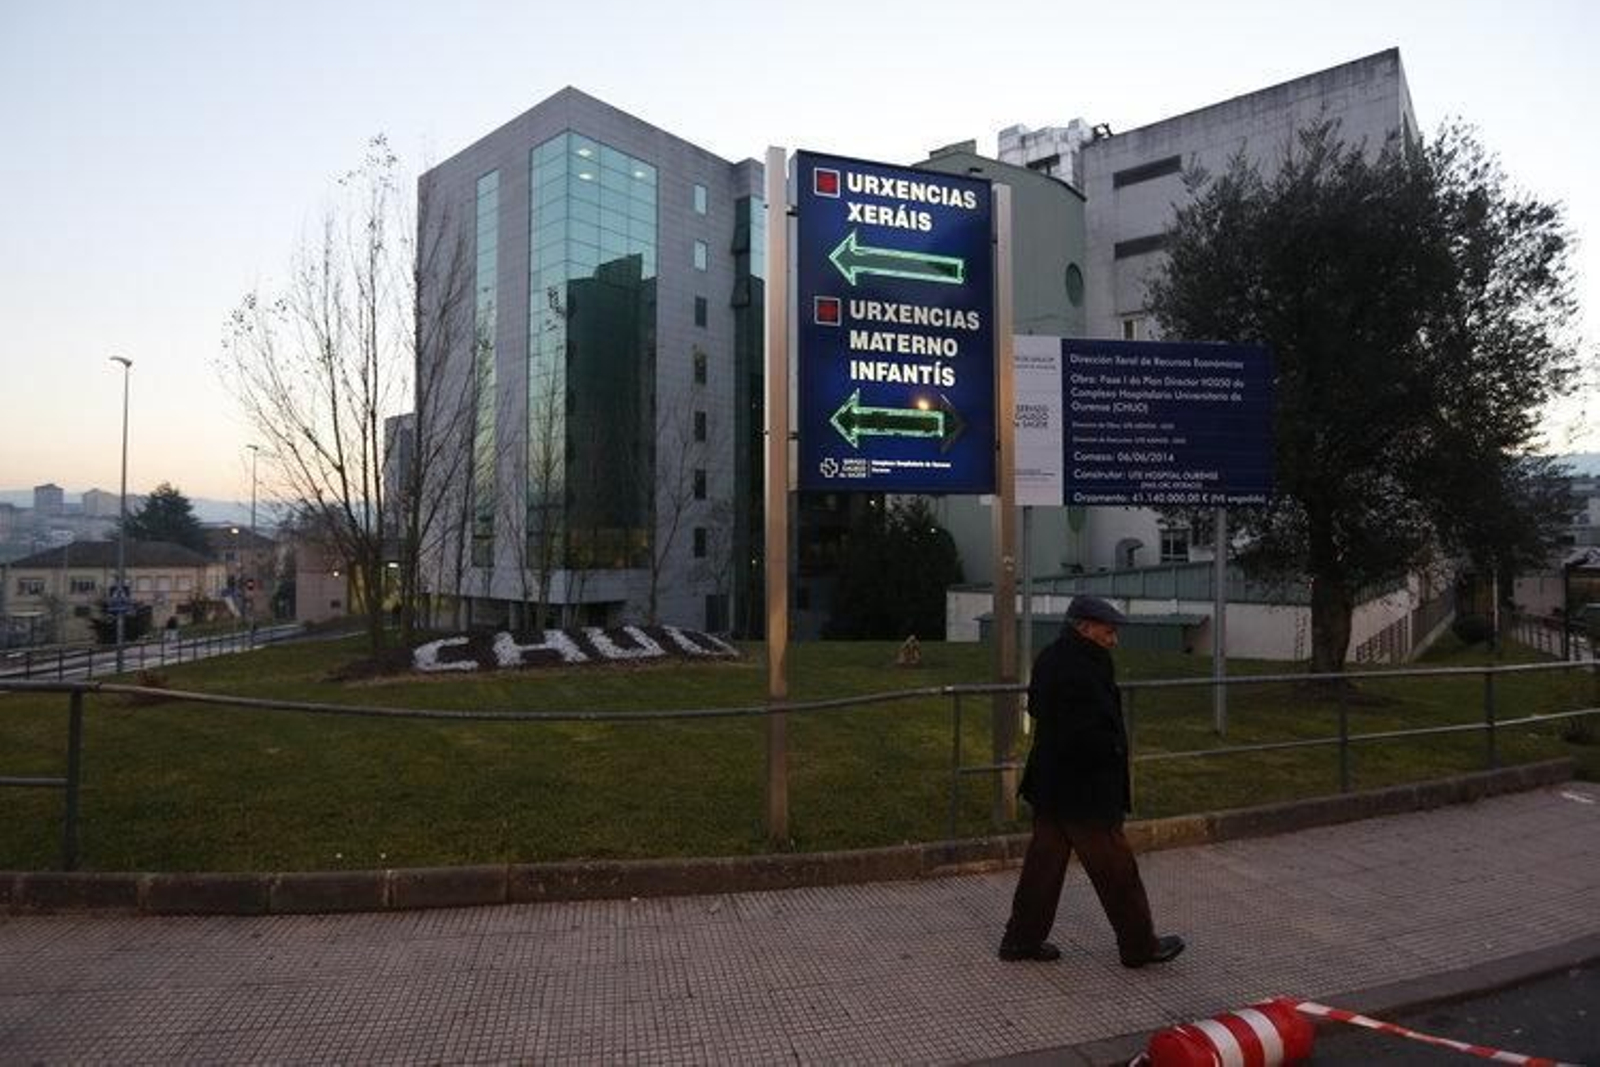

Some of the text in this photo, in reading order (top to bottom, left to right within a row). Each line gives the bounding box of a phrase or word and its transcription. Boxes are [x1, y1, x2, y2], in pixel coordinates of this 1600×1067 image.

[847, 172, 977, 210] URXENCIAS
[847, 202, 933, 232] XERÁIS
[850, 299, 980, 331] URXENCIAS
[850, 329, 959, 358] MATERNO
[1070, 353, 1113, 365] Dirección
[1153, 357, 1192, 368] Recursos
[850, 359, 957, 387] INFANTÍS
[1142, 376, 1163, 388] Plan
[1164, 377, 1199, 388] Director
[1070, 387, 1117, 400] Complexo
[1119, 389, 1173, 400] Hospitalario
[1174, 390, 1229, 401] Universitario
[1070, 401, 1149, 414] Ourense (CHUO)
[1117, 452, 1175, 463] 06/06/2014
